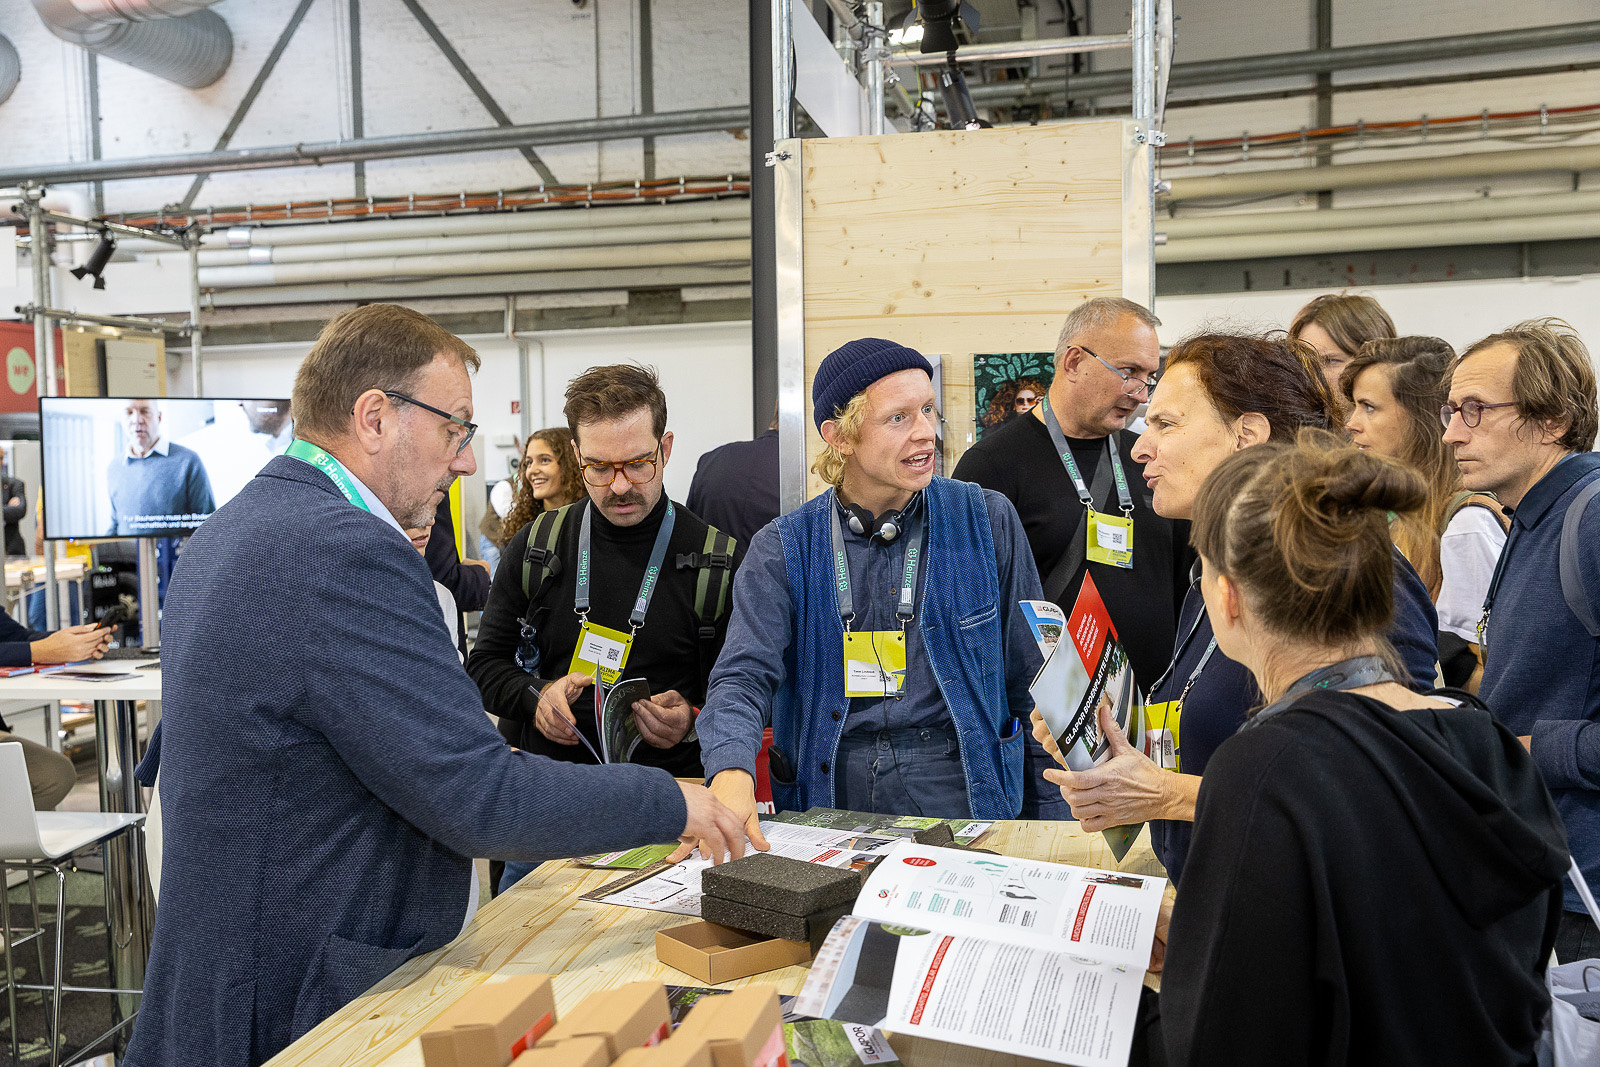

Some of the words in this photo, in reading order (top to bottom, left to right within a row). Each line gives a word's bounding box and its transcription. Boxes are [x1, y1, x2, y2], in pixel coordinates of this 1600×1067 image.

[1065, 460, 1079, 480] Heinz
[579, 550, 588, 576] Heinze
[837, 551, 846, 580] Heinze
[904, 559, 916, 588] Heinze
[1065, 711, 1086, 745] GLAPOR
[1083, 659, 1107, 713] BODENPLATTE
